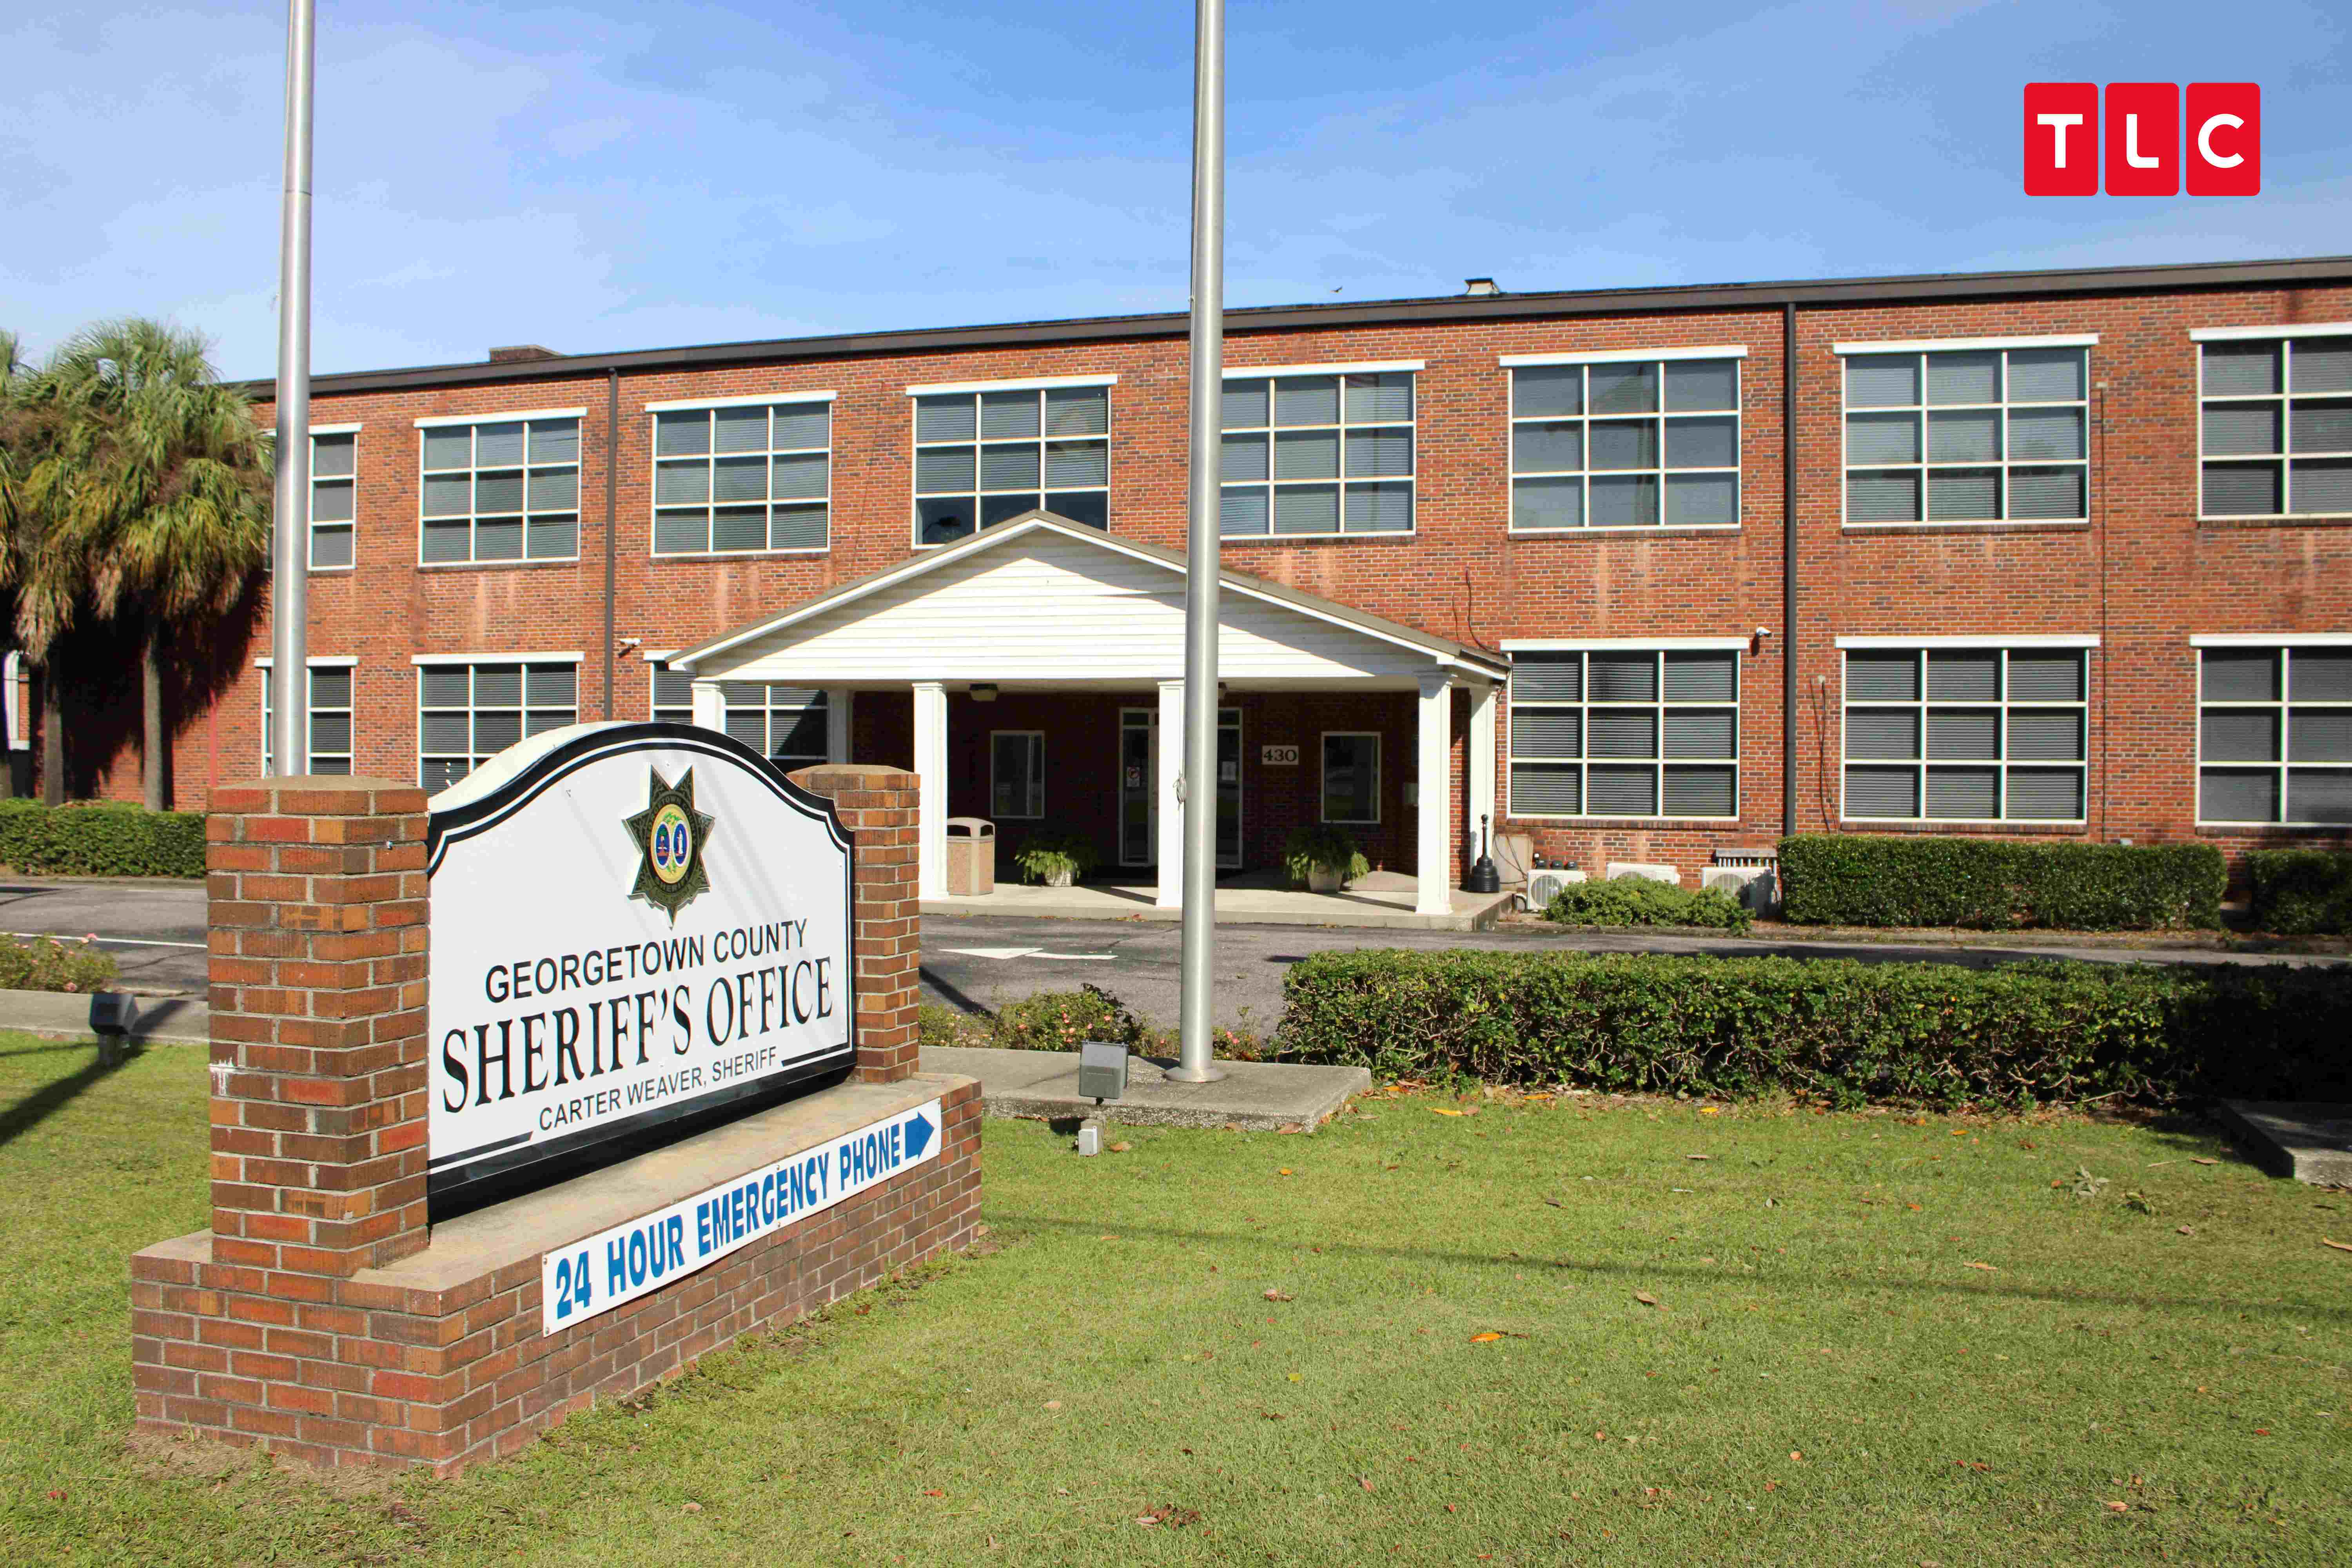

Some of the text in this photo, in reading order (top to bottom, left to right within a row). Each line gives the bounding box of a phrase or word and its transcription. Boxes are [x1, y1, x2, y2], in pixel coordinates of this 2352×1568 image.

[1263, 748, 1298, 762] 430
[486, 918, 807, 1004] GEORGETOWN COUNTY
[443, 956, 833, 1113] SHERIFF'S OFFICE
[539, 1045, 777, 1131] CARTER WEAVER, SHERIFF
[556, 1123, 900, 1319] 24 HOUR EMERGENCY PHONE
